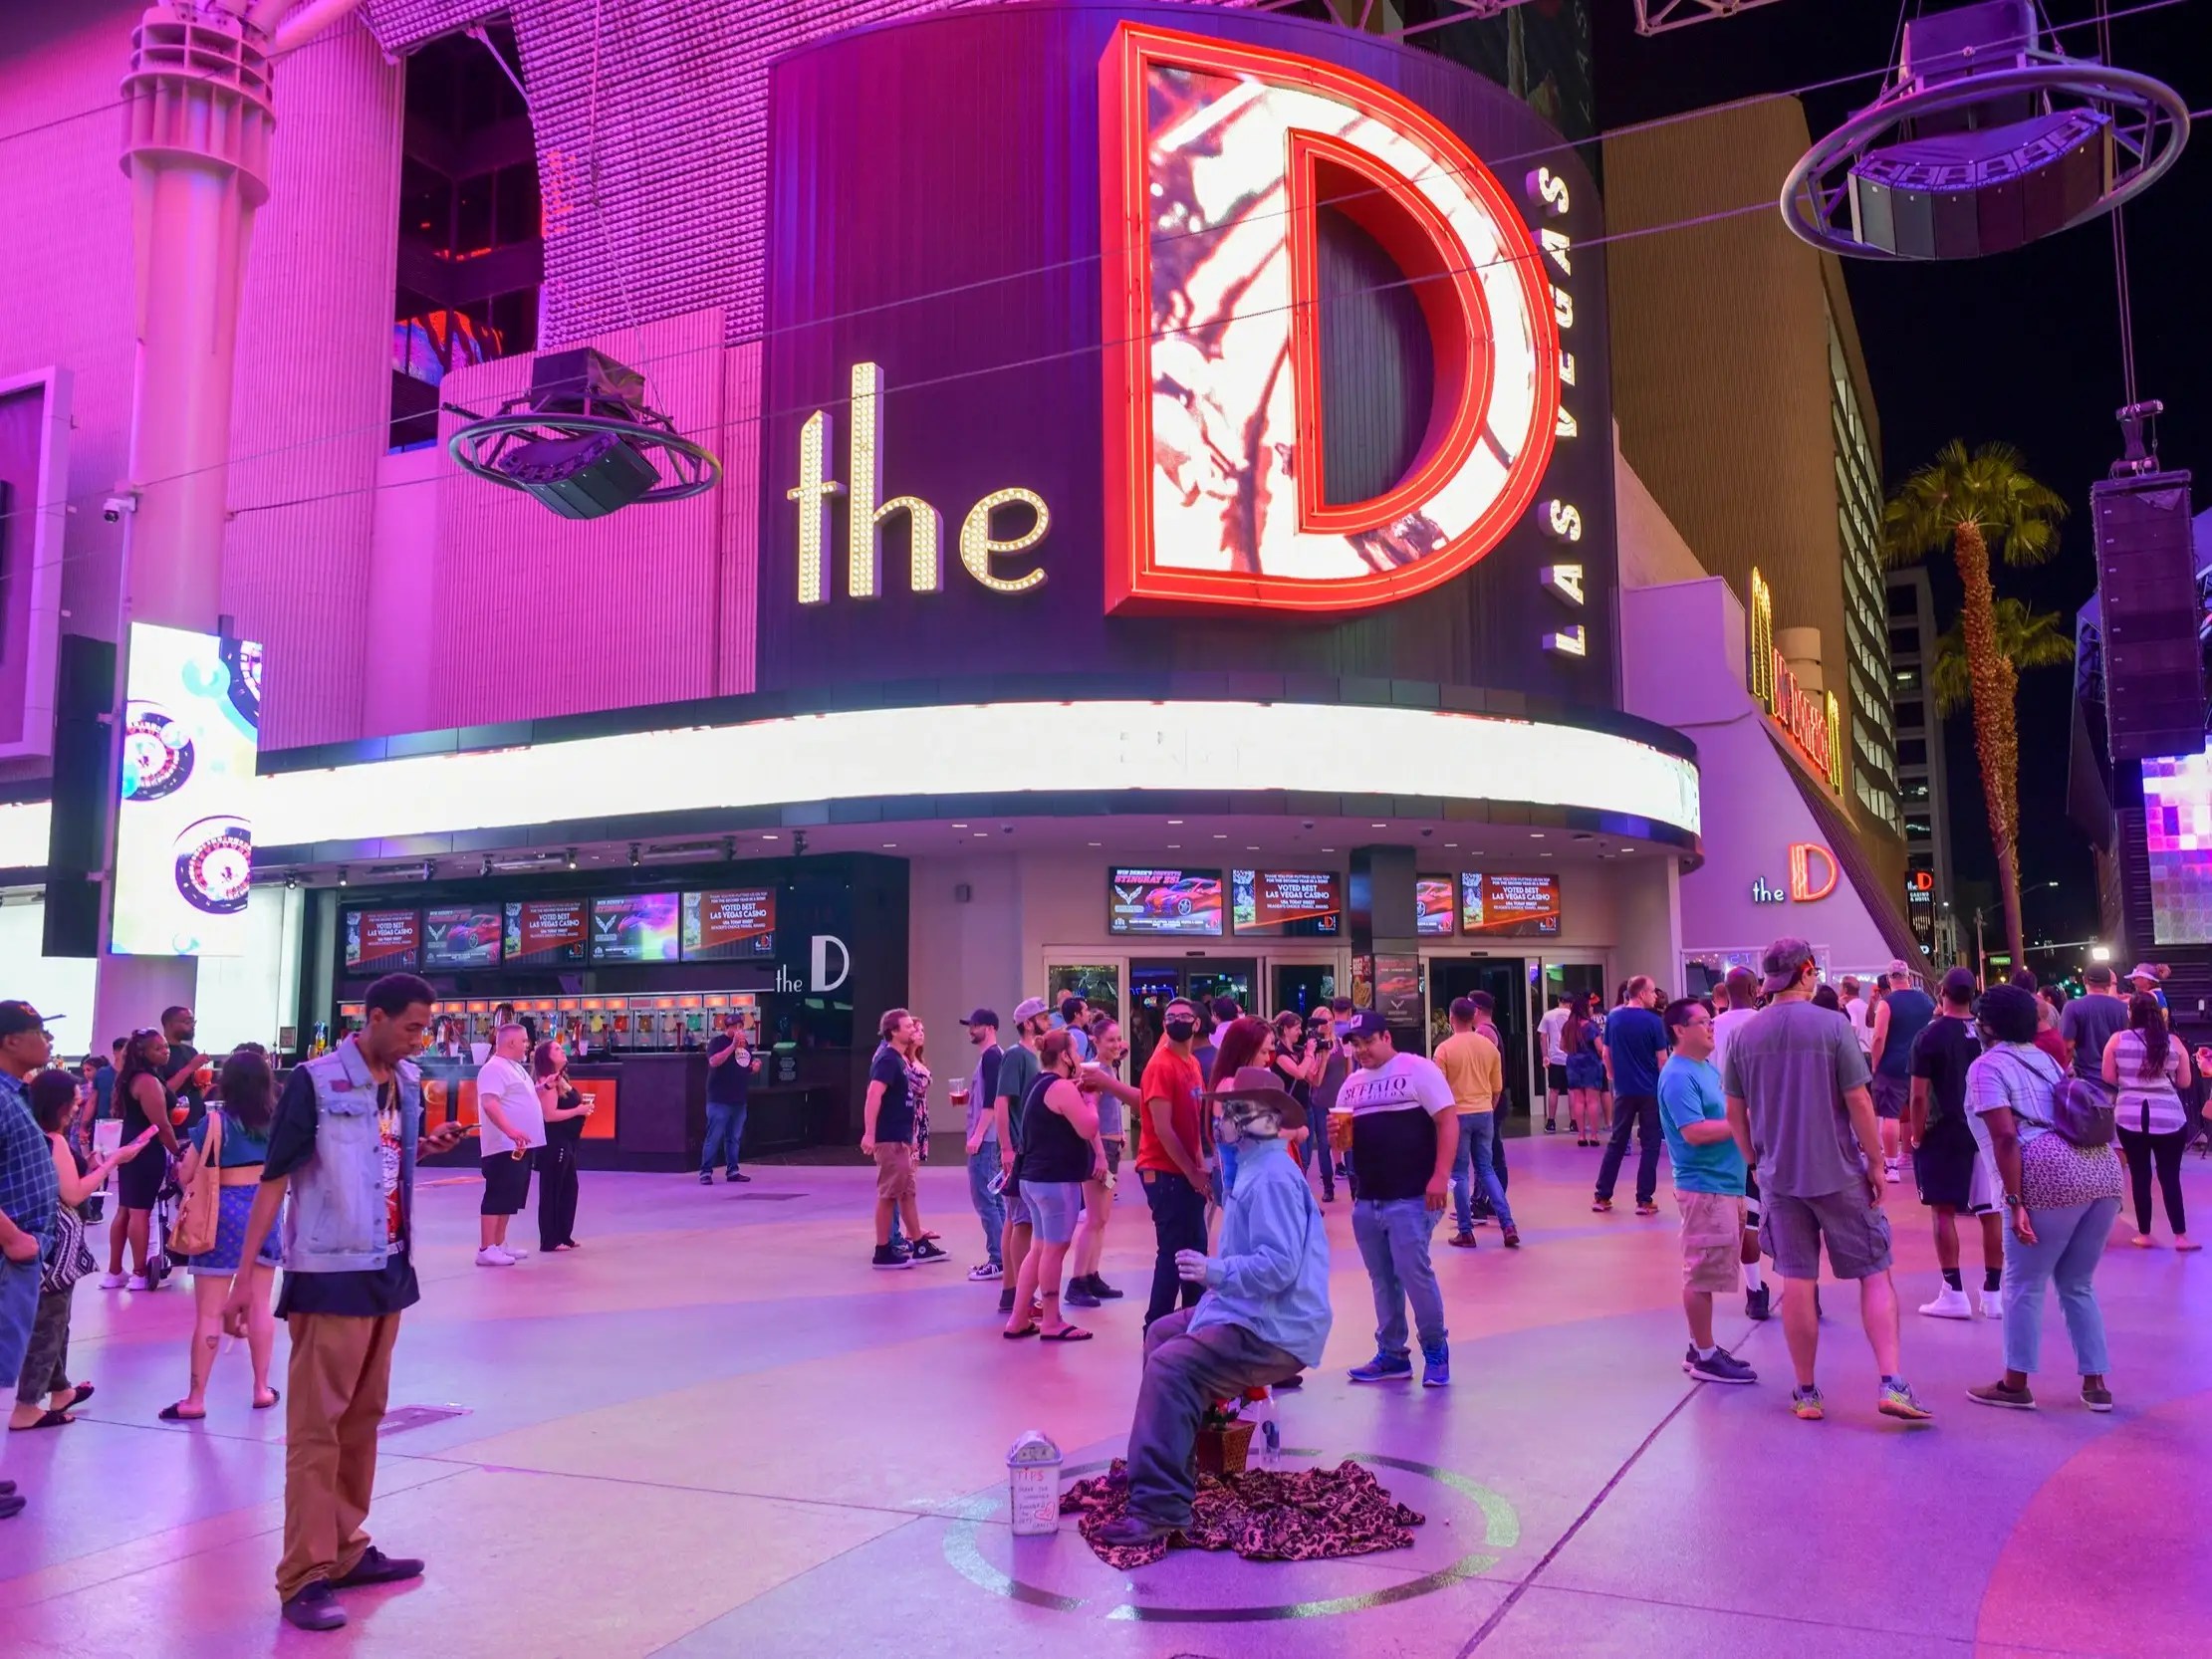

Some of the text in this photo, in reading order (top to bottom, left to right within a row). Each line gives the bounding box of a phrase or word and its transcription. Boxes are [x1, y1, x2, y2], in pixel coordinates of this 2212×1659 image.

[788, 20, 1561, 615] the D
[1531, 165, 1587, 658] LAS VEGAS
[1752, 843, 1841, 902] the D
[1917, 872, 1932, 890] D
[776, 935, 850, 993] the D
